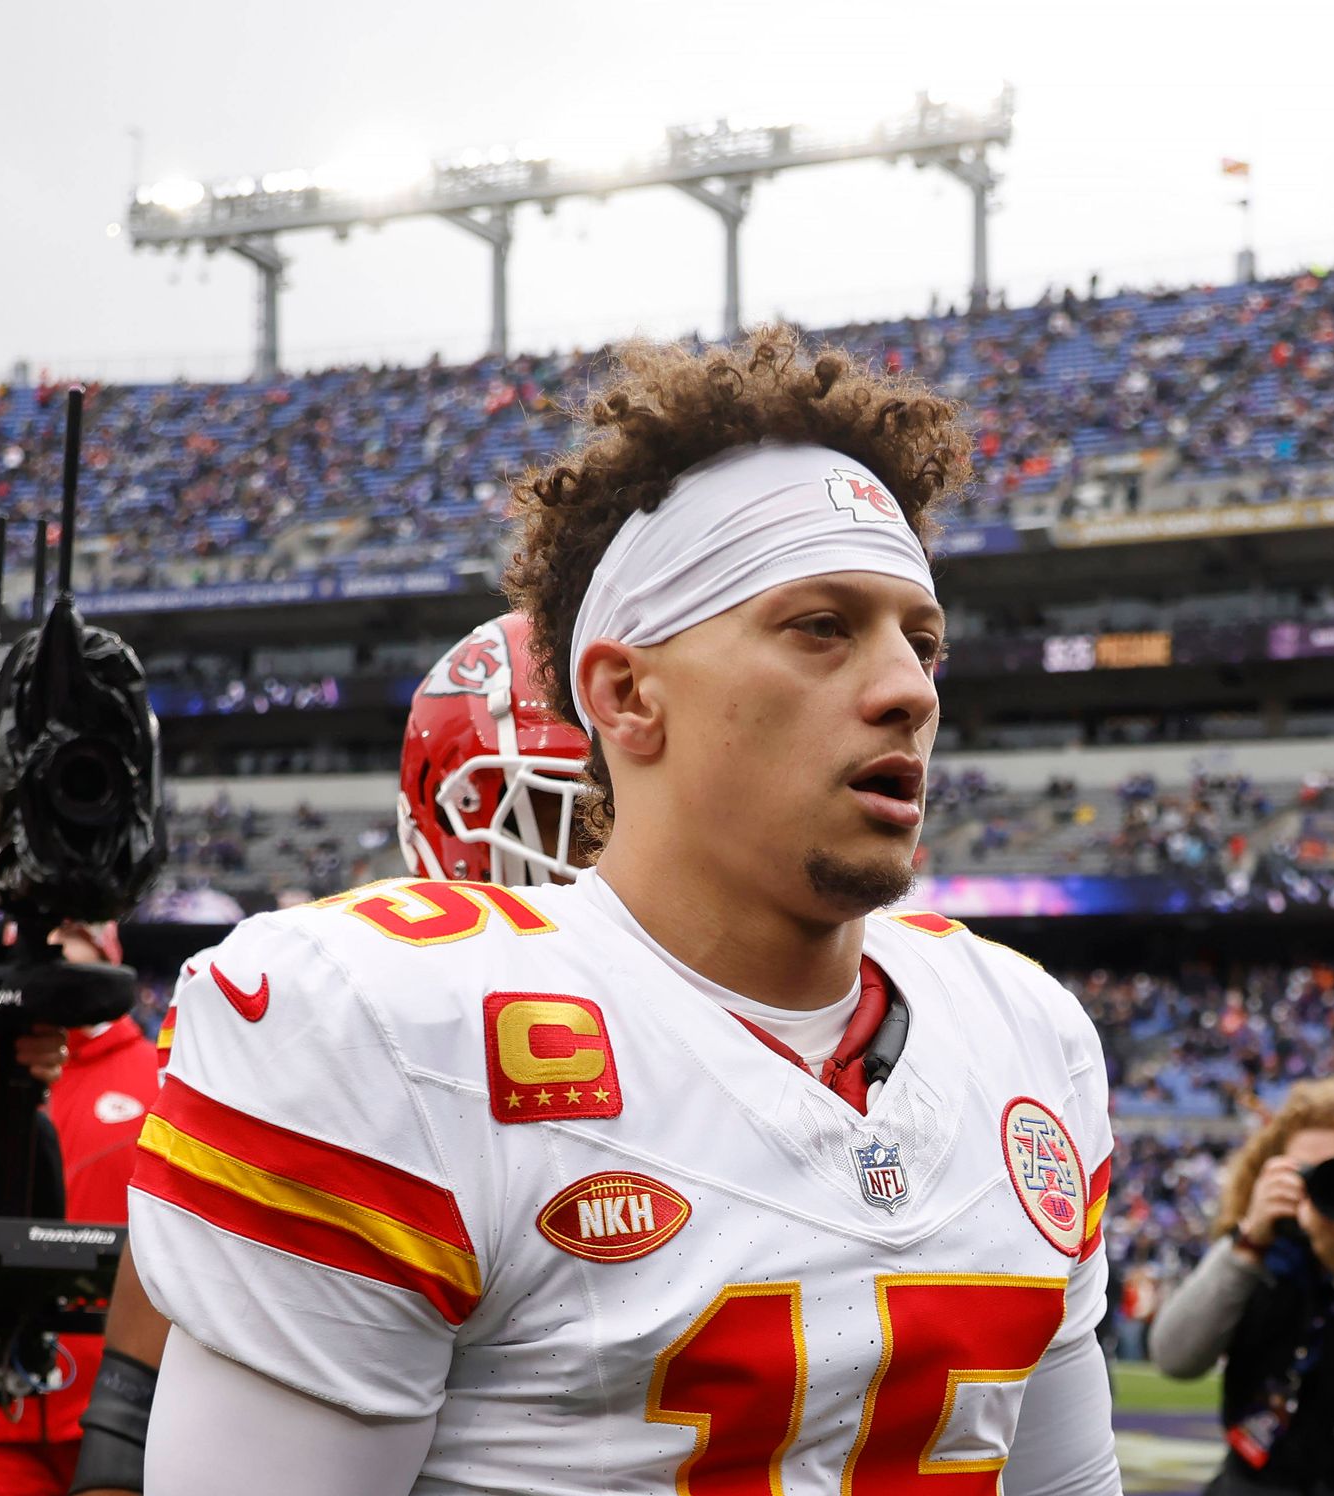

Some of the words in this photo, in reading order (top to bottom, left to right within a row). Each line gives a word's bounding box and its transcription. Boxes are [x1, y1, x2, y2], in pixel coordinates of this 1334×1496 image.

[496, 1000, 606, 1085] C
[867, 1169, 904, 1199] NFL
[577, 1194, 656, 1239] NKH
